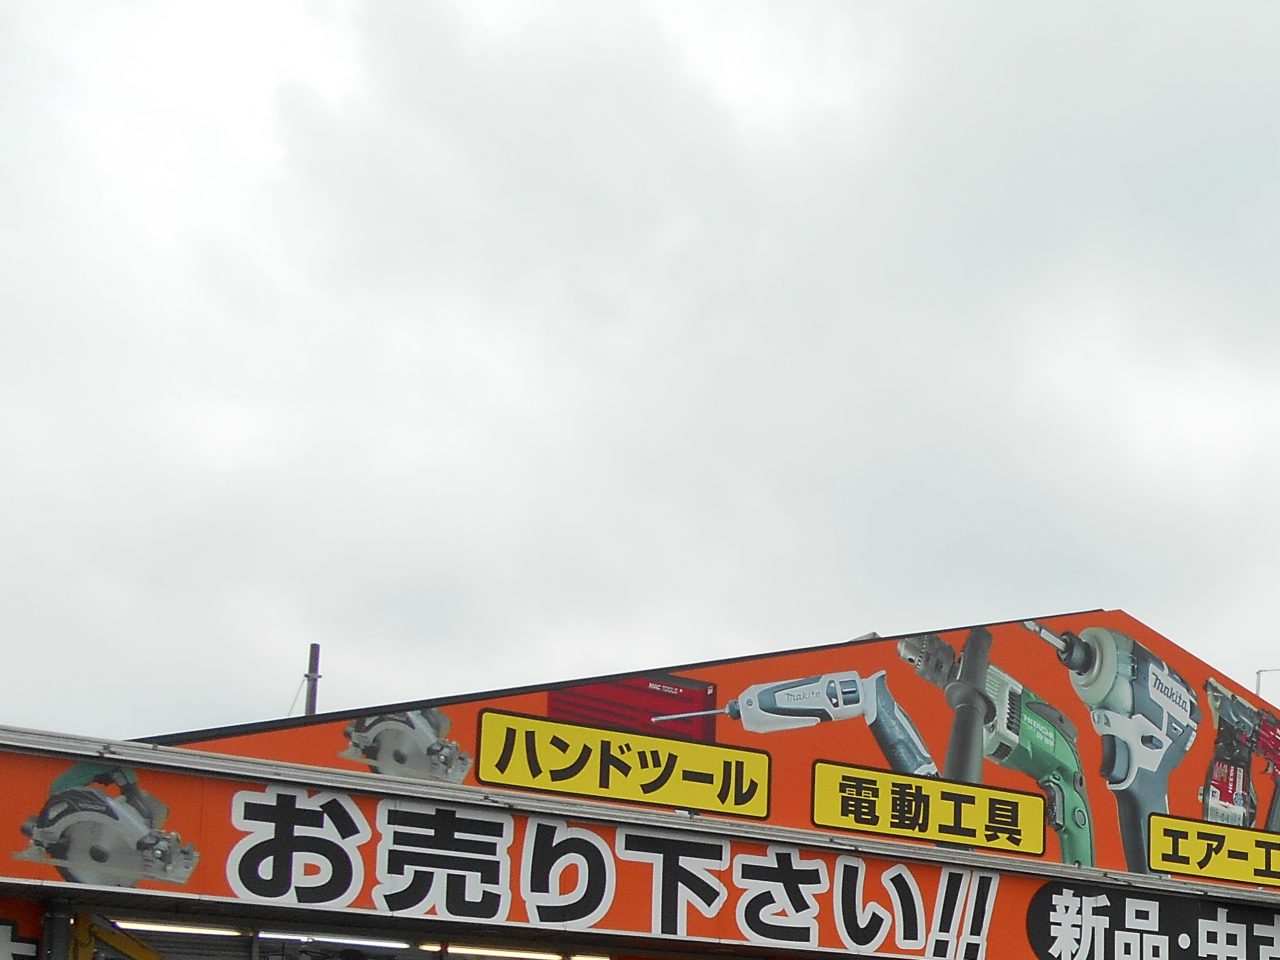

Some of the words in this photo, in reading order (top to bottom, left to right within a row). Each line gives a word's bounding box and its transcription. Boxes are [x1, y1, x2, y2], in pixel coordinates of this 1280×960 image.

[494, 726, 759, 806] ハンドツール
[838, 775, 1023, 846] 電動工具
